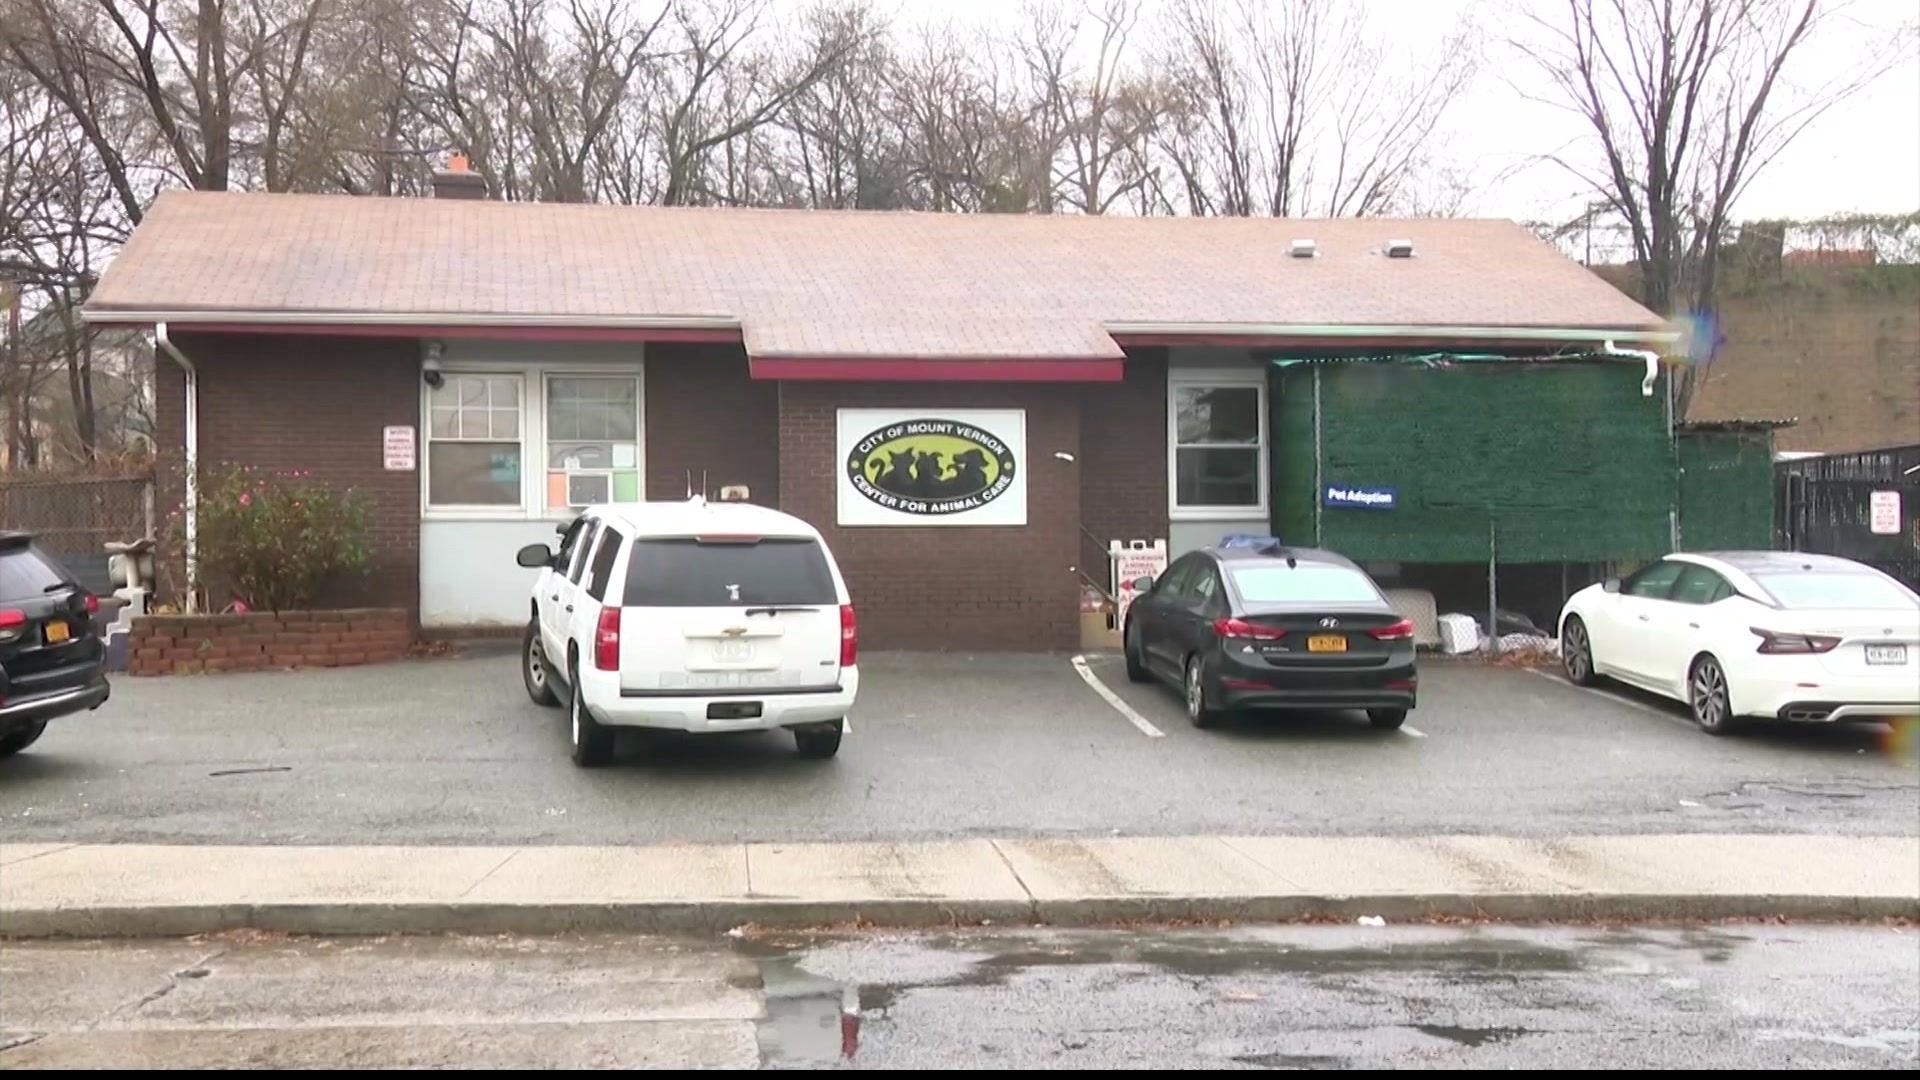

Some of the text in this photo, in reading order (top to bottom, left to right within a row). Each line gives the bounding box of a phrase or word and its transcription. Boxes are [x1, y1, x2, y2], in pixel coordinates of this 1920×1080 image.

[859, 423, 1004, 455] CITY OF MOUNT VERNON
[853, 474, 1011, 512] CENTER FOR ANIMAL CARE
[1328, 487, 1392, 504] Pet Adoption
